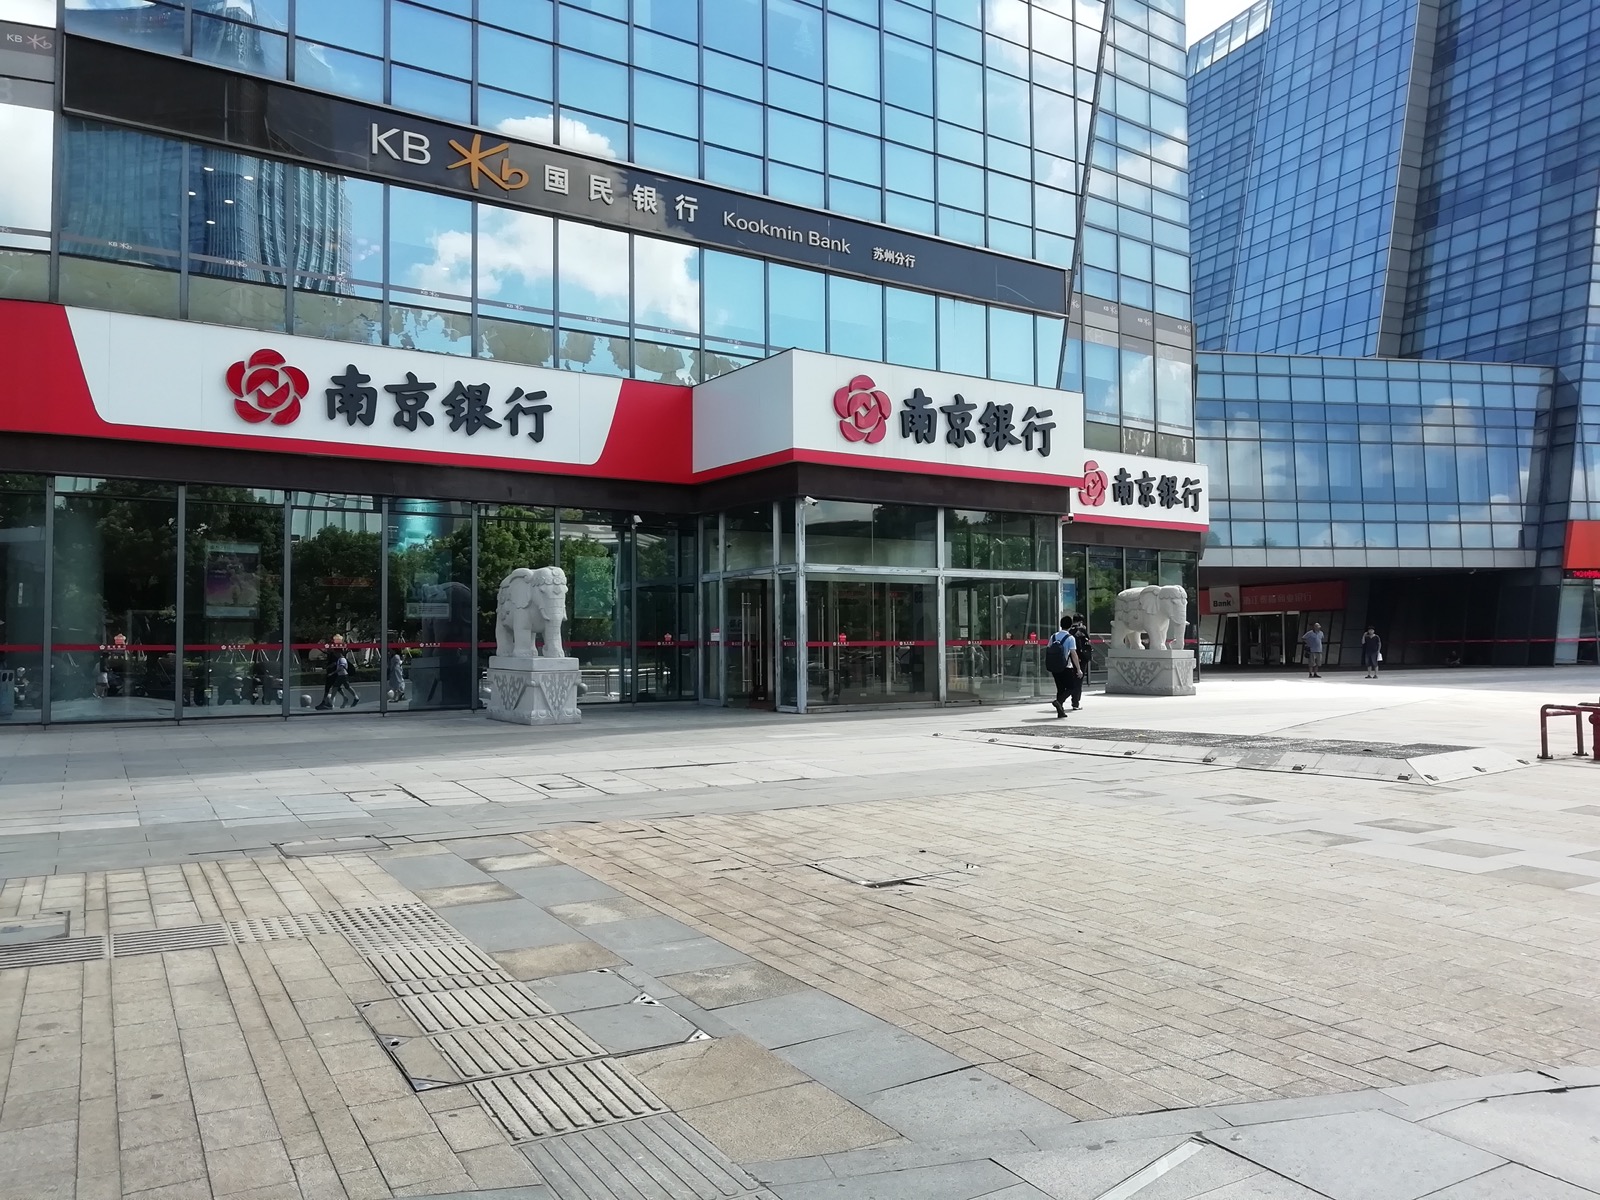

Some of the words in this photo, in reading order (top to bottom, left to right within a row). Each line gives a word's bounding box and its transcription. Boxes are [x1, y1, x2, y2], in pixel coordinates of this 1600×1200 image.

[7, 33, 23, 43] KB
[371, 122, 431, 165] KB
[543, 163, 699, 223] 国民银行
[722, 210, 803, 243] Kookmin
[808, 230, 852, 255] Bank
[872, 246, 916, 268] 苏州分行
[1213, 599, 1232, 608] Bank
